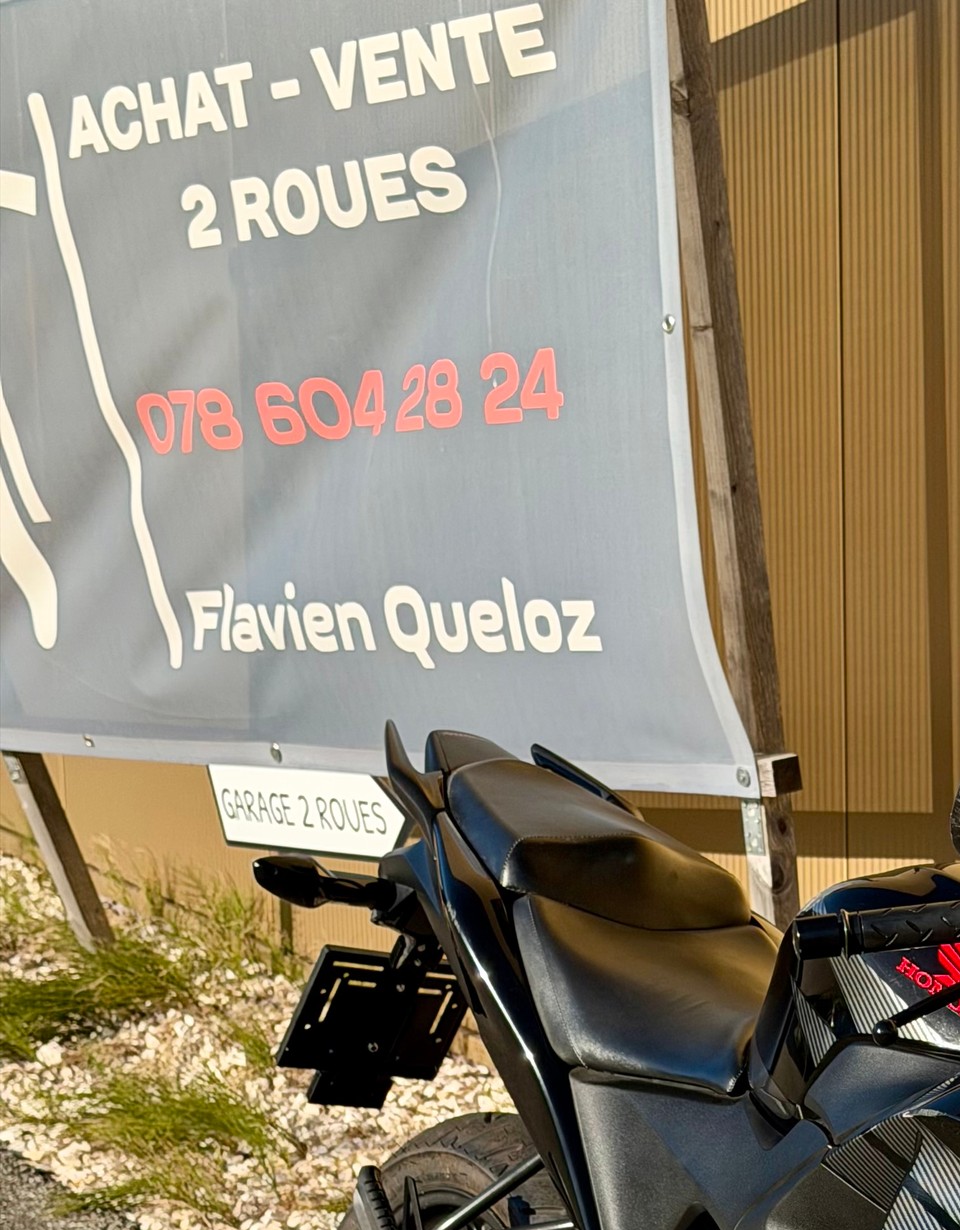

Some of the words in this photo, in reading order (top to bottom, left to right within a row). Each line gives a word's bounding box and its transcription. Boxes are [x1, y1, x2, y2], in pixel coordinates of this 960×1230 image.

[68, 62, 254, 158] ACHAT
[310, 3, 556, 111] VENTE
[181, 184, 221, 249] 2
[230, 145, 467, 242] ROUES
[136, 388, 243, 455] 078
[480, 347, 564, 425] 24
[185, 582, 376, 653] Flavien
[385, 577, 602, 669] Queloz
[221, 788, 295, 826] GARAGE
[298, 795, 314, 827] 2
[315, 796, 387, 835] ROUES
